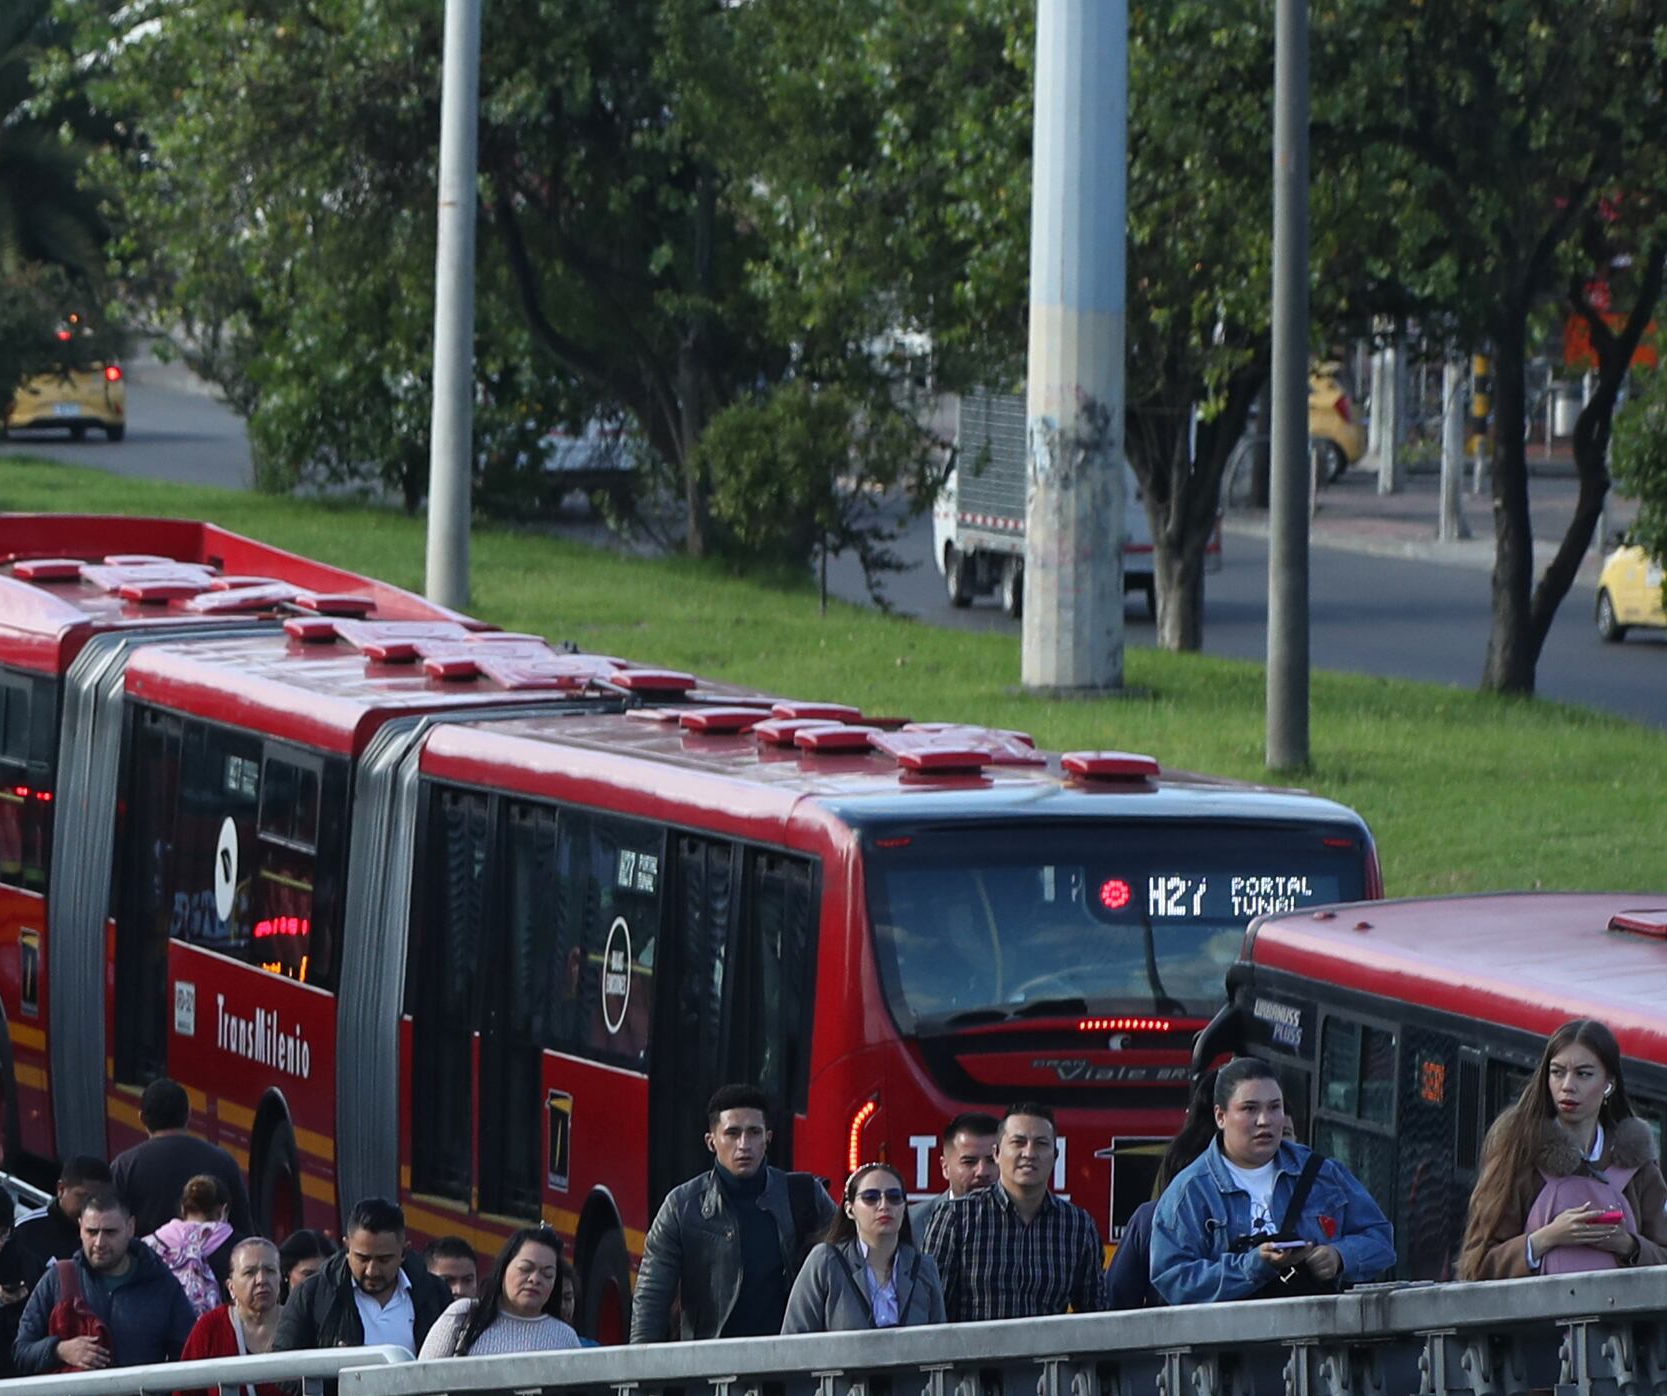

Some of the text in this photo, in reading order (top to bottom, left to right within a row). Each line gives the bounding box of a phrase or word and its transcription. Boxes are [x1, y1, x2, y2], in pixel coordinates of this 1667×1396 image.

[1147, 876, 1314, 917] H27 PORTAL
[1253, 998, 1302, 1028] URBANUSS
[217, 993, 311, 1079] TransMilenio
